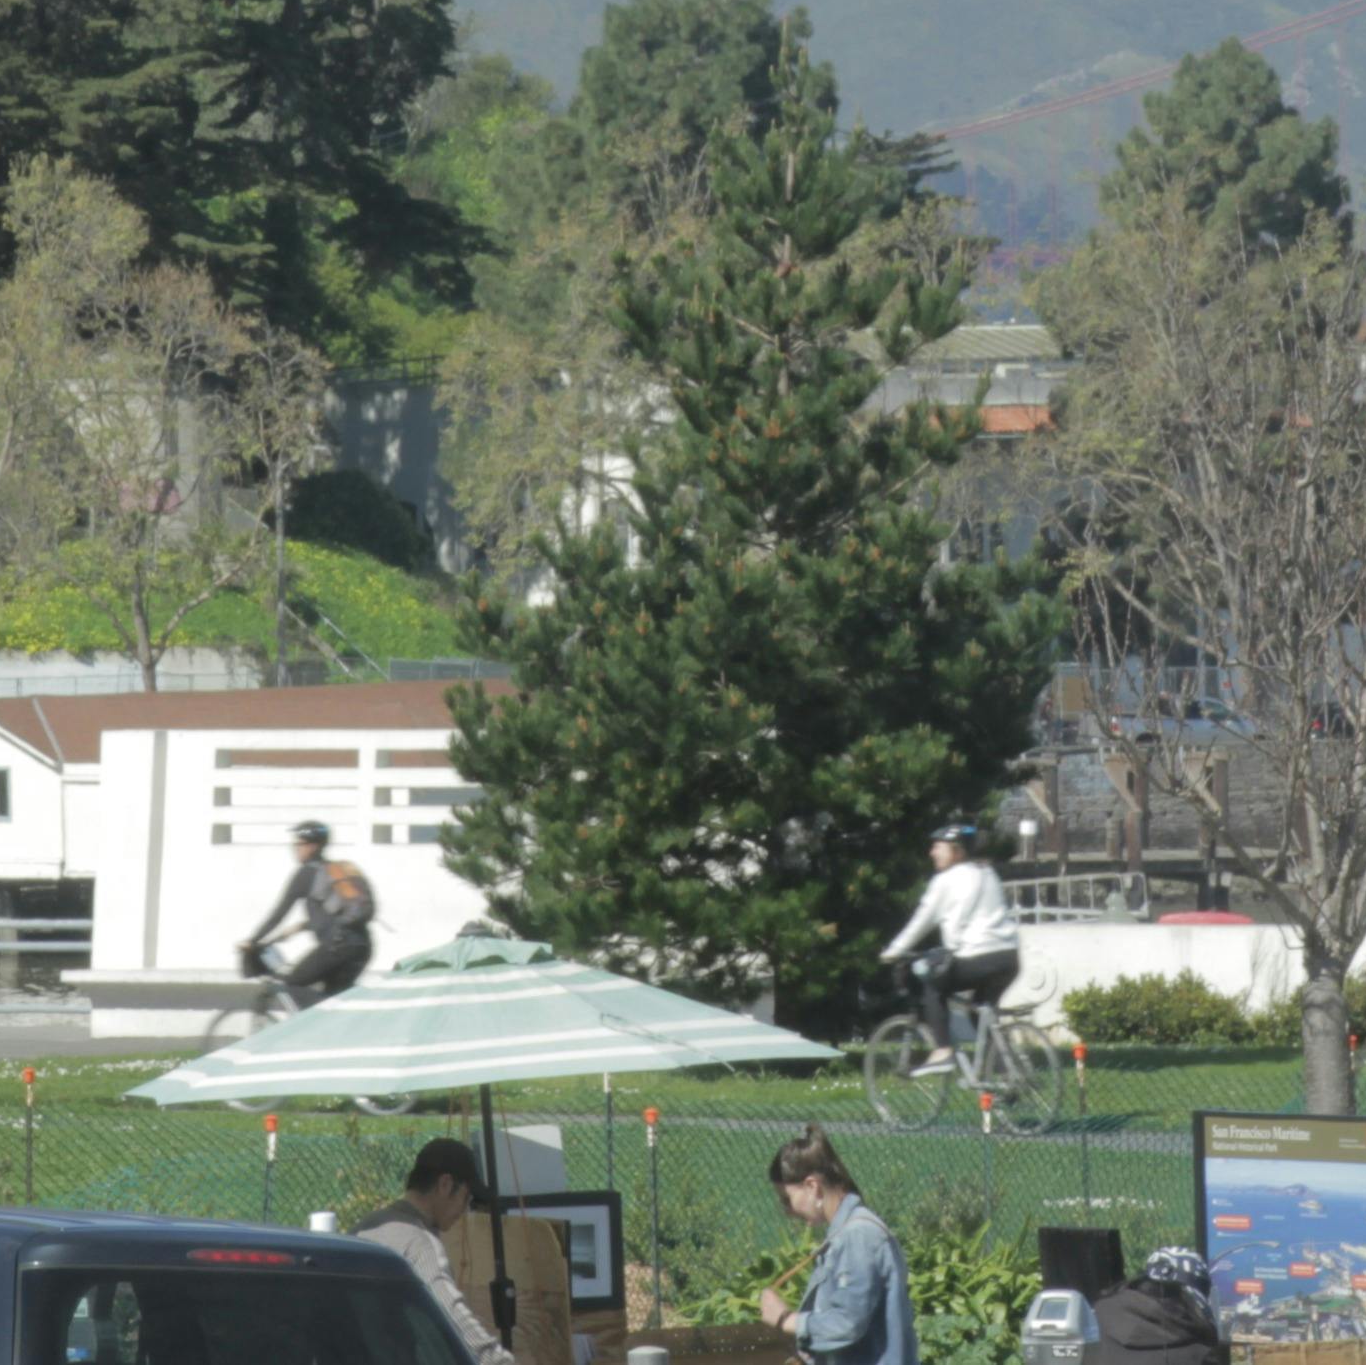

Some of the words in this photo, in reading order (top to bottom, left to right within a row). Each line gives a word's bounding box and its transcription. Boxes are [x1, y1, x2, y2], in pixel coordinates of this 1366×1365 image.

[1212, 1125, 1228, 1139] San
[1230, 1125, 1271, 1140] Francisco
[1272, 1126, 1311, 1141] Maritime
